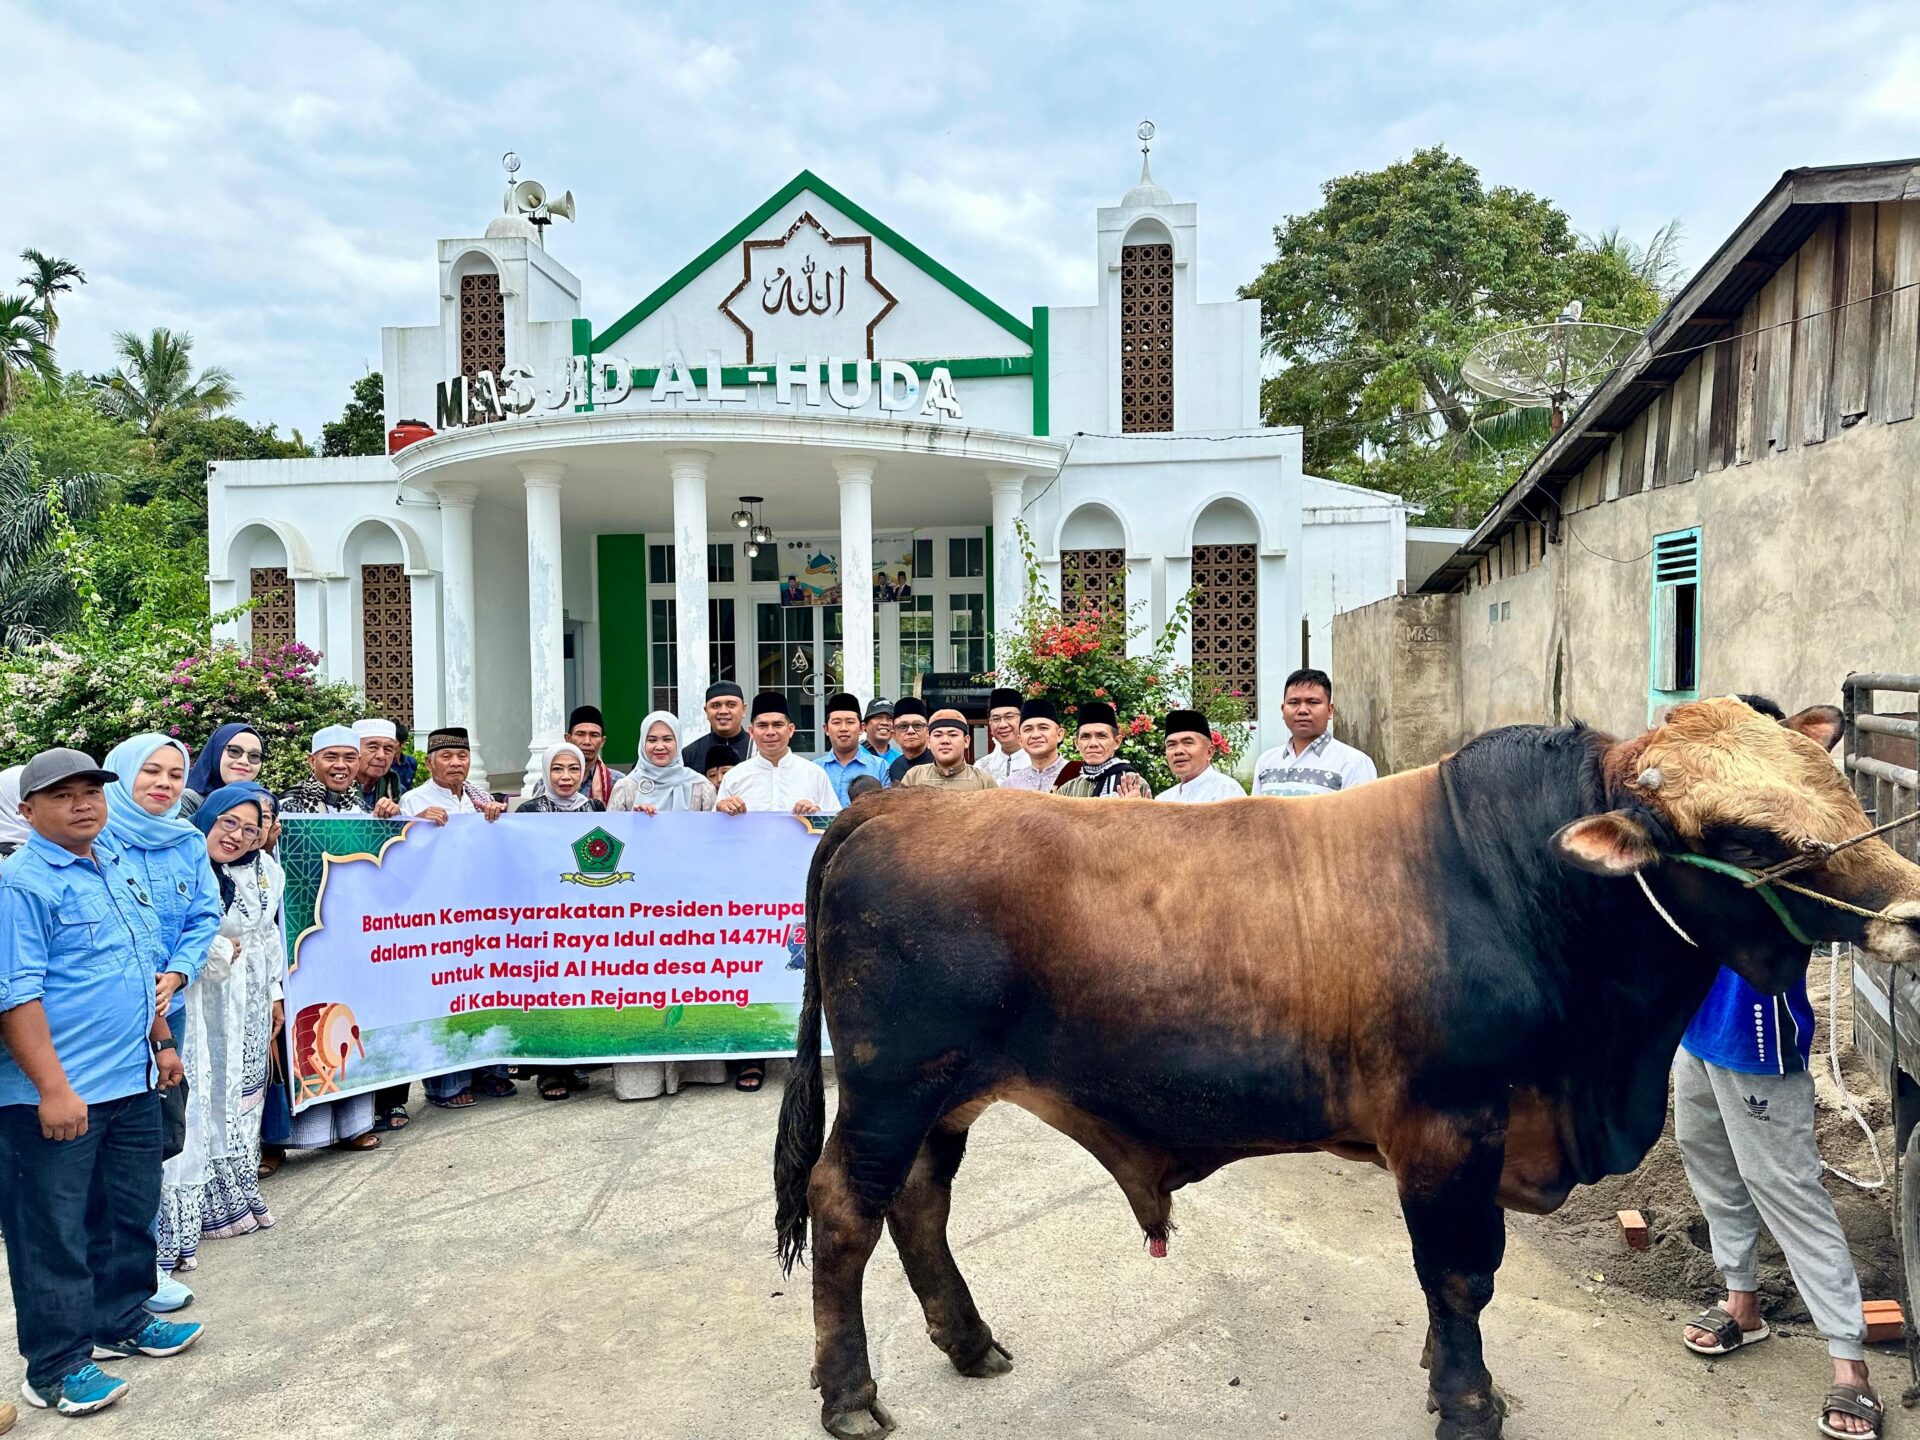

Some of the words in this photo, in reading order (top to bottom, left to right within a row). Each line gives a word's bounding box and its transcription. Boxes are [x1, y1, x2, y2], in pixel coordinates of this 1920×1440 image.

[436, 352, 634, 430] MASJID
[649, 349, 964, 419] AL-HUDA
[362, 912, 436, 933] Bantuan
[440, 903, 625, 925] Kemasyarakatan
[630, 900, 723, 918] Presiden
[728, 901, 804, 921] berupa
[370, 944, 427, 963] dalam
[431, 934, 501, 957] rangka
[505, 931, 548, 949] Hari
[553, 932, 609, 953] Raya
[614, 930, 655, 947] Idul
[659, 930, 715, 946] adha
[431, 964, 485, 986] untuk
[490, 960, 559, 983] Masjid
[564, 961, 586, 977] Al
[591, 960, 648, 977] Huda
[653, 958, 706, 975] desa
[710, 958, 763, 979] Apur
[450, 994, 465, 1013] di
[469, 990, 586, 1012] Kabupaten
[591, 987, 666, 1010] Rejang
[671, 986, 749, 1007] Lebong
